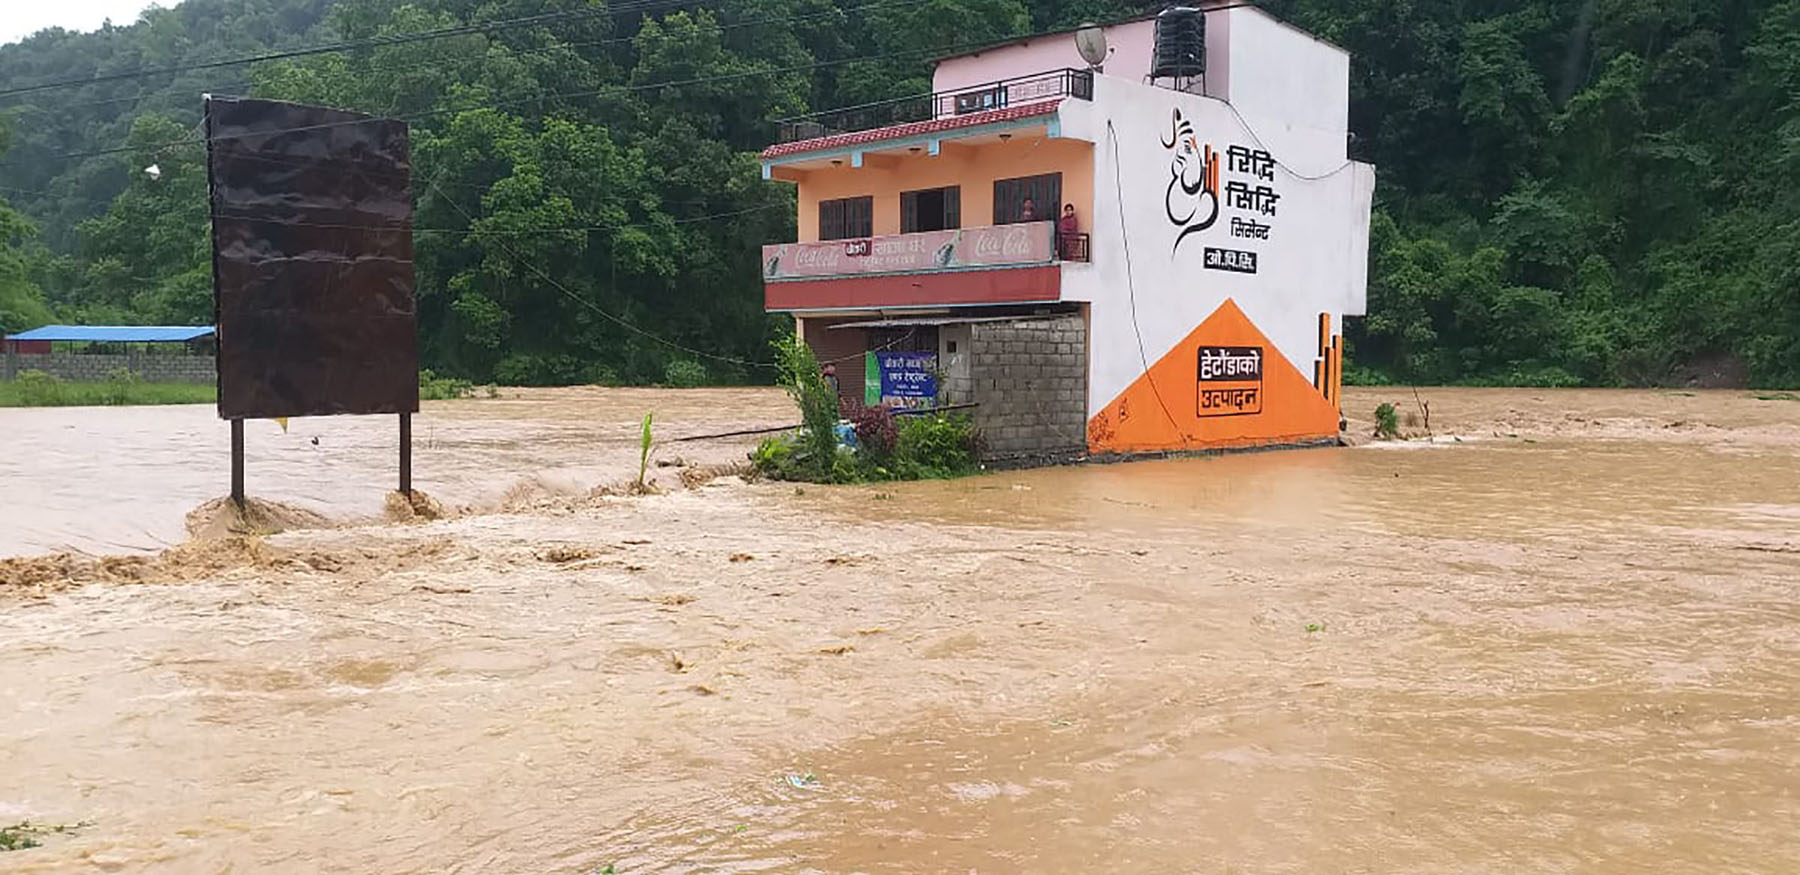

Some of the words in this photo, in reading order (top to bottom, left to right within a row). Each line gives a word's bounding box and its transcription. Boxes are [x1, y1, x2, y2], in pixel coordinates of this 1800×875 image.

[1226, 145, 1277, 181] रिद्धि
[1225, 181, 1280, 216] सिद्धि
[1231, 217, 1271, 239] सिमेन्ट
[1201, 388, 1259, 411] उत्पादन
